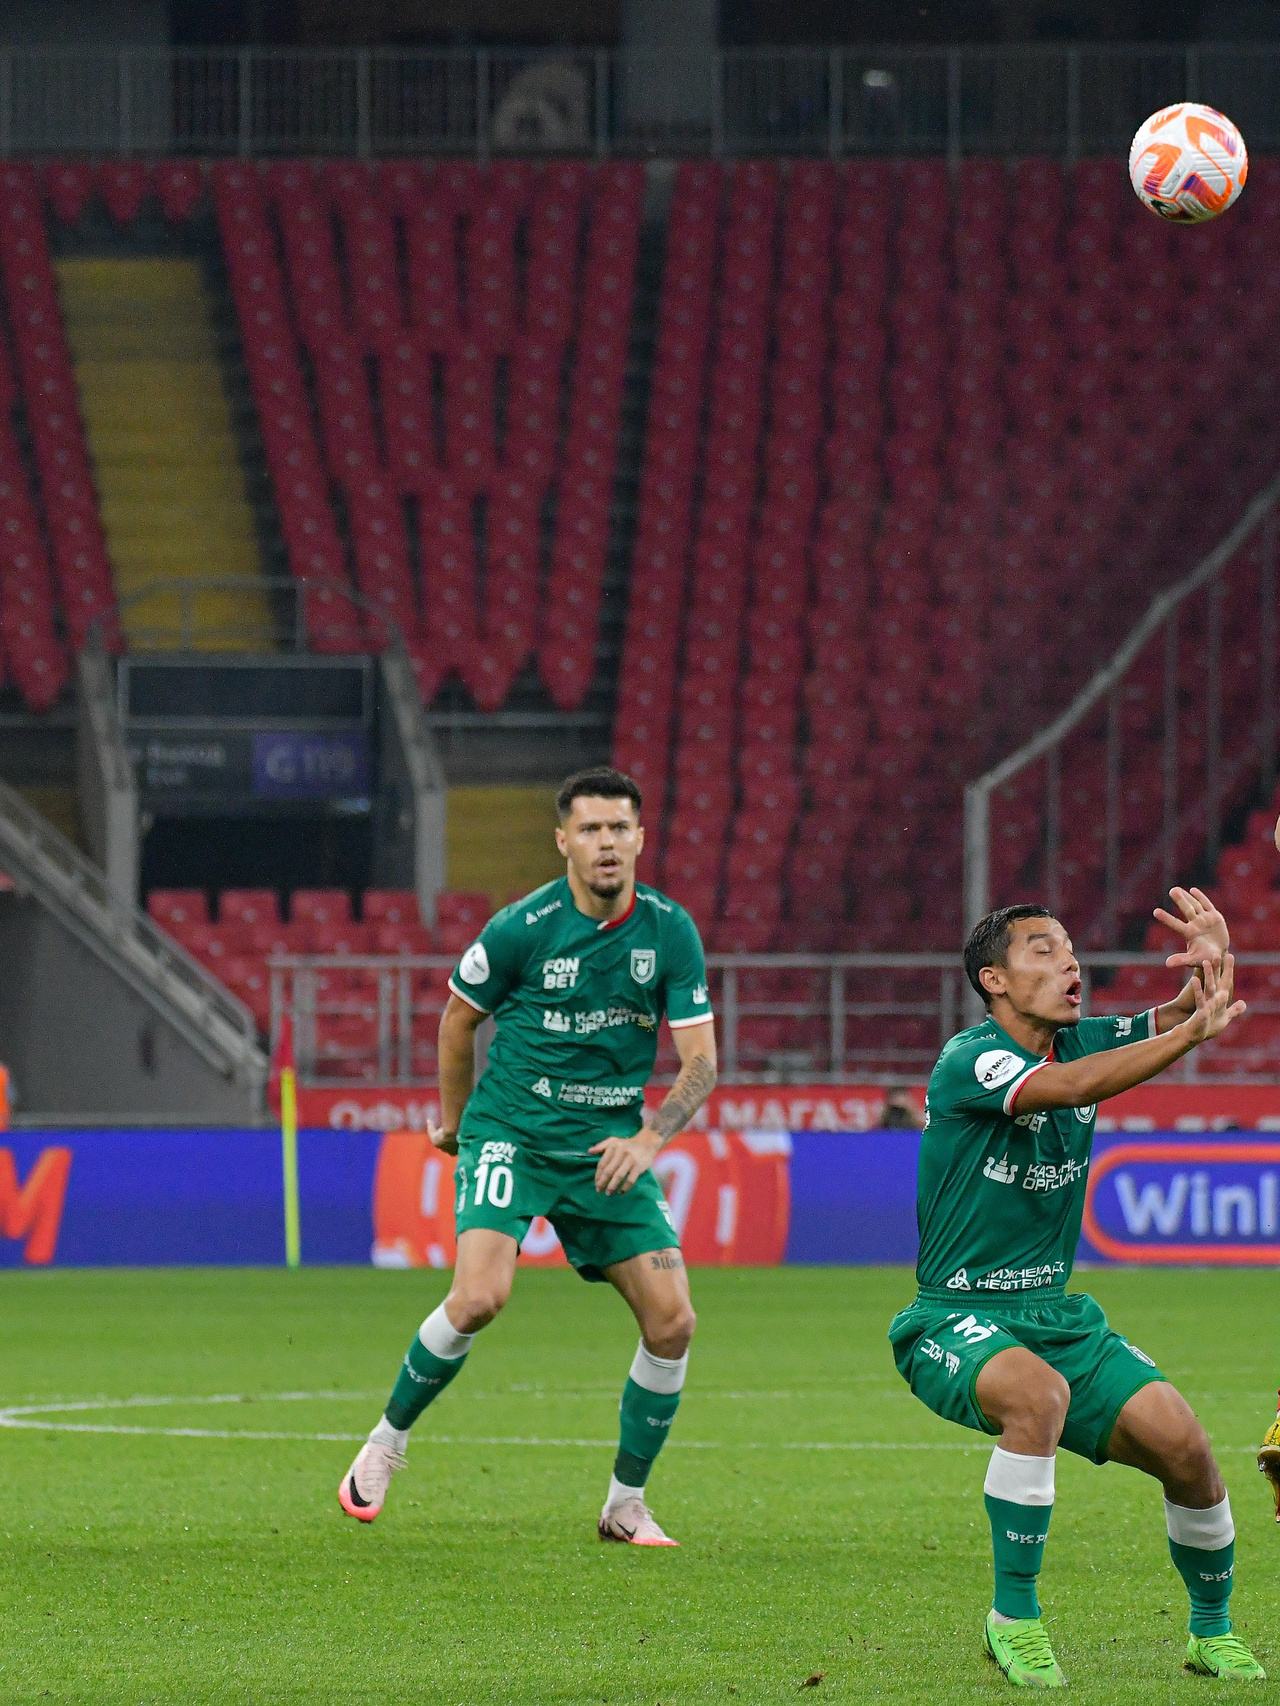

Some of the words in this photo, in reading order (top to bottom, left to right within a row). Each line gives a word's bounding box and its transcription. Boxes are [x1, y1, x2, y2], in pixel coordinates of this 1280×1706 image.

[542, 957, 580, 975] FON
[543, 973, 579, 990] BET
[719, 1100, 888, 1131] МАГАЗ
[481, 1141, 518, 1158] FON
[474, 1163, 514, 1209] 10
